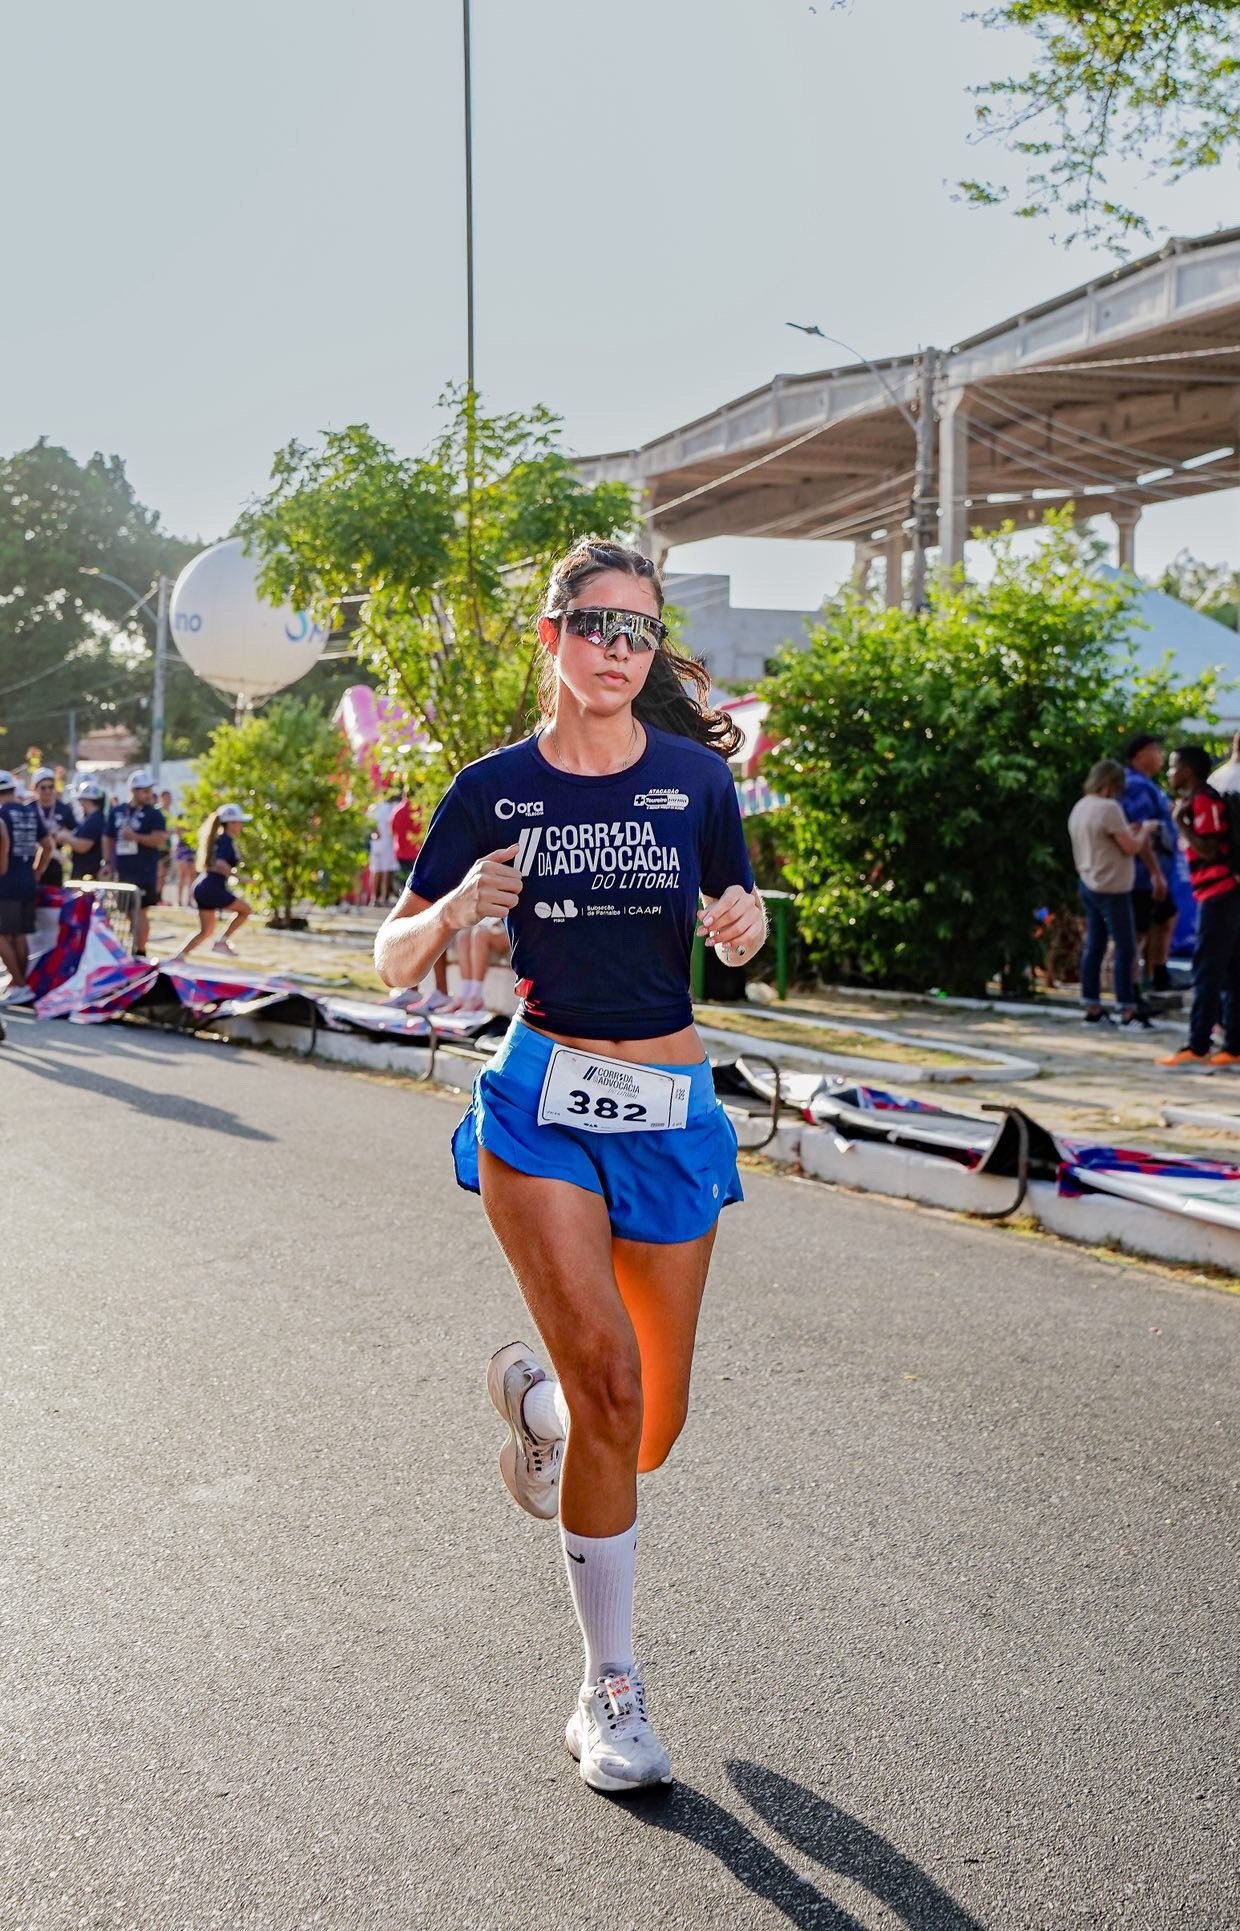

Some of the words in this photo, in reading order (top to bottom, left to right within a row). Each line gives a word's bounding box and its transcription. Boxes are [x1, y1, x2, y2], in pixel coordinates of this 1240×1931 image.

[517, 801, 544, 814] ora
[545, 821, 657, 851] CORRIDA
[538, 851, 553, 877] DA
[553, 846, 681, 876] ADVOCACIA
[591, 873, 616, 890] DO
[619, 872, 680, 889] LITORAL
[534, 899, 579, 919] OAB
[628, 906, 662, 915] CAAPI
[597, 1077, 641, 1094] ADVOCACIA
[567, 1090, 647, 1123] 382
